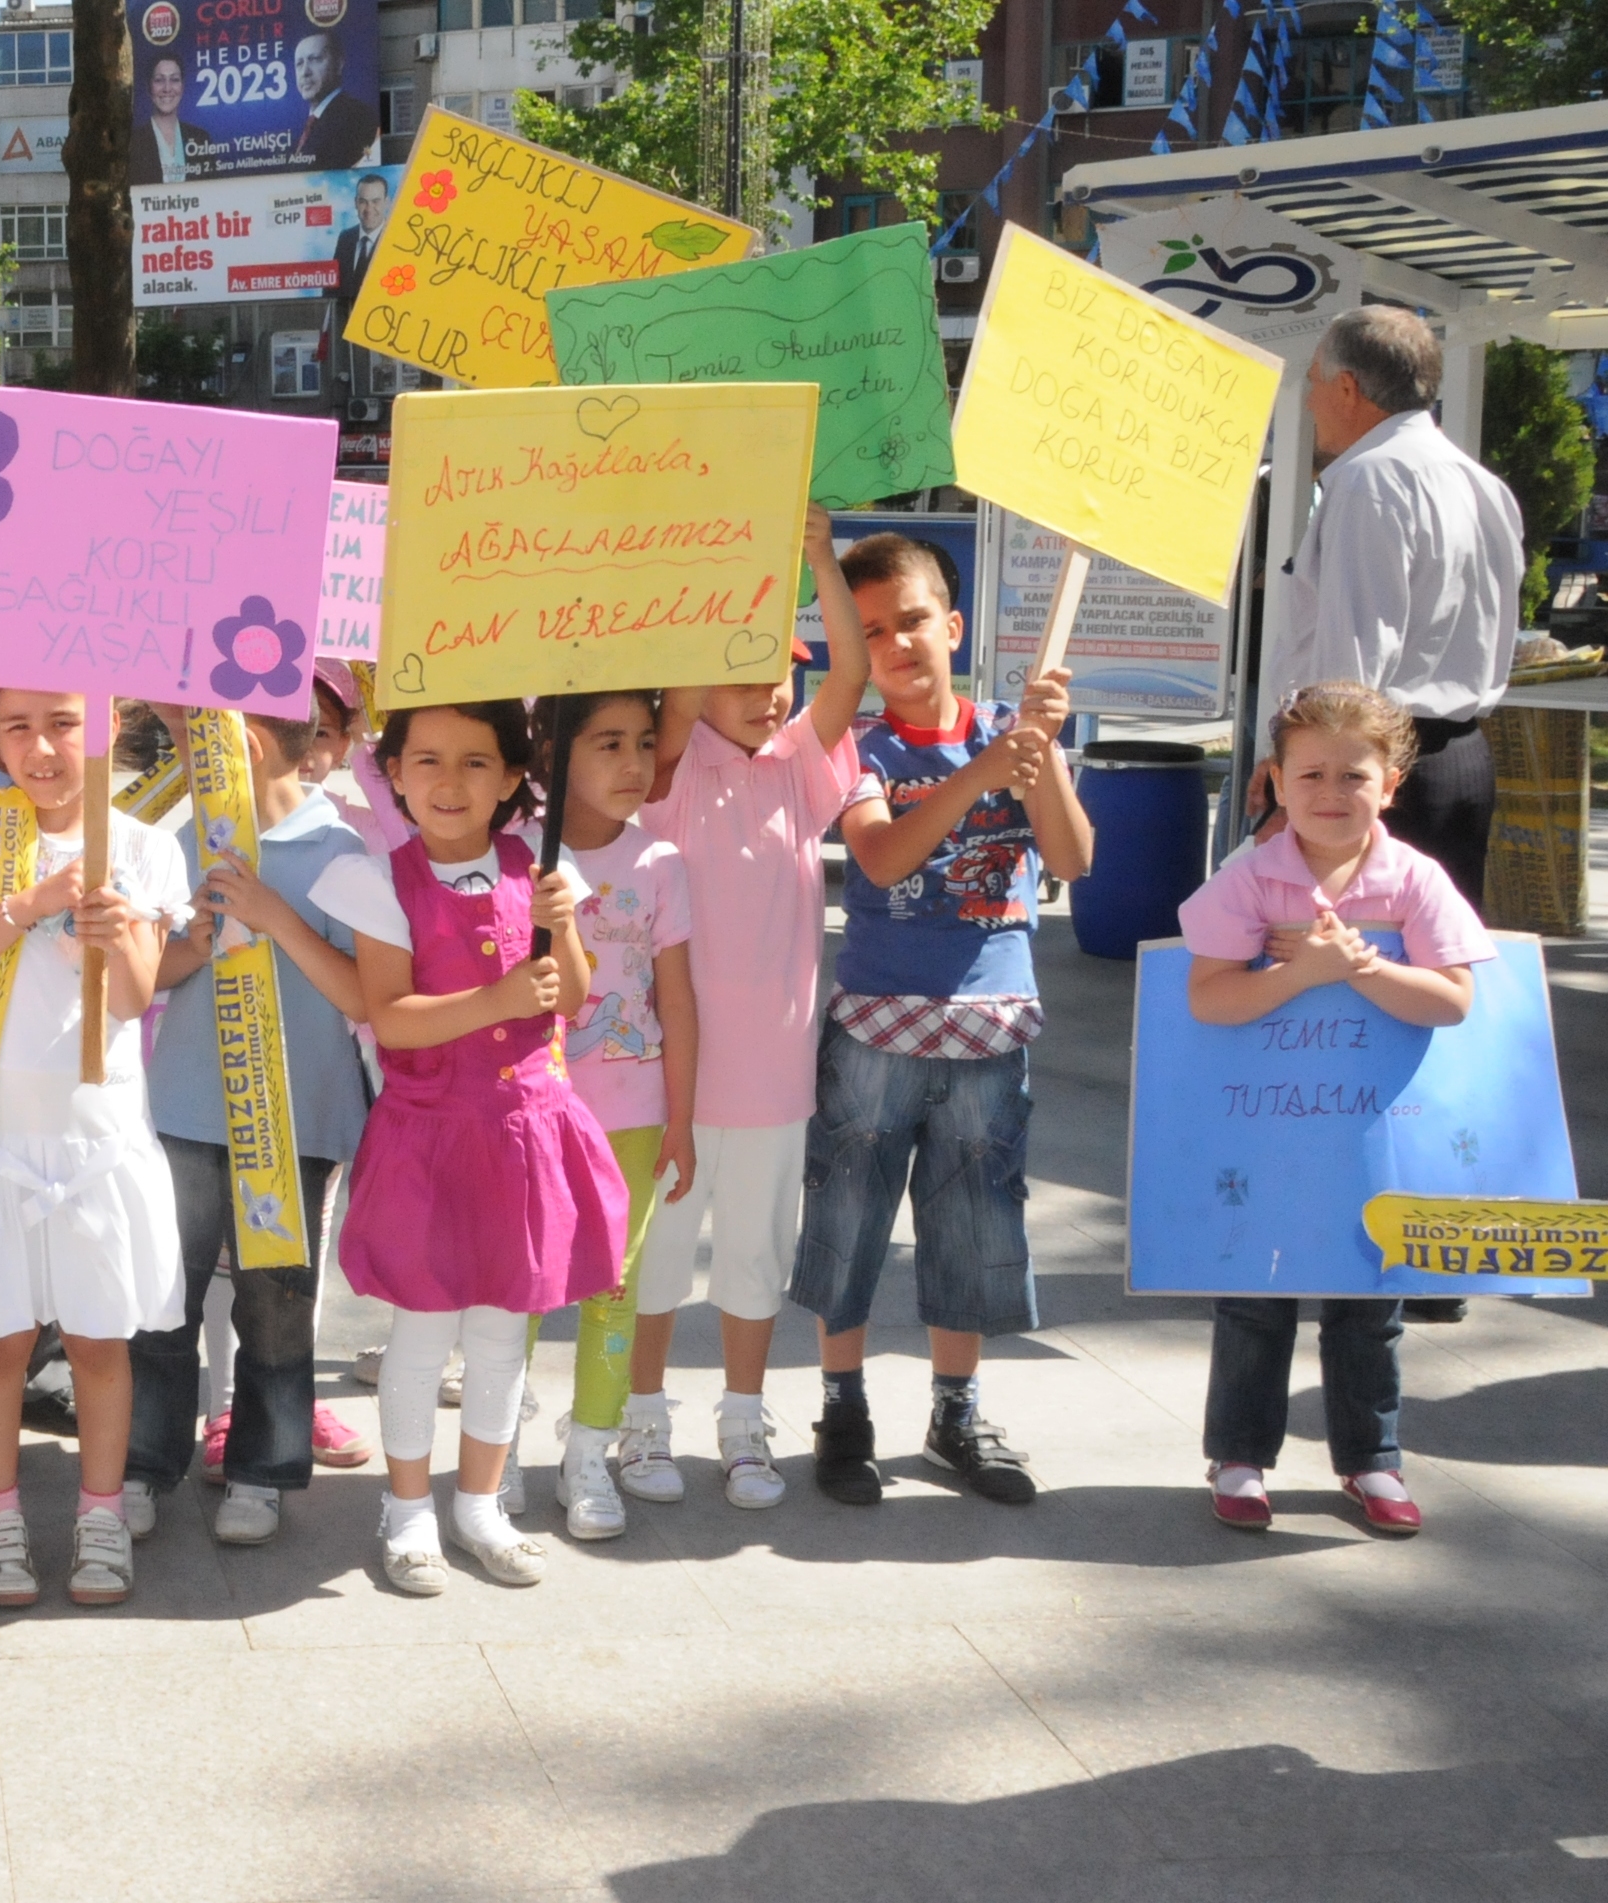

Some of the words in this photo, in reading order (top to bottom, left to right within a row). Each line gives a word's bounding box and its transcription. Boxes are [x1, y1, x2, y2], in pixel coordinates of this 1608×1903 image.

[197, 22, 284, 46] HAZIR
[196, 41, 284, 67] HEDEF
[196, 61, 288, 107] 2023
[36, 136, 67, 148] ABA
[185, 138, 230, 157] Özlem
[234, 129, 292, 152] YEMİŞÇİ
[141, 196, 200, 213] Türkiye
[275, 212, 300, 225] CHP
[141, 215, 209, 243] rahat
[216, 211, 251, 238] bir
[518, 205, 664, 279] YAŞAM
[142, 245, 213, 273] nefes
[143, 278, 198, 295] alacak.
[231, 279, 248, 291] Av.
[251, 276, 281, 290] EMRE
[285, 270, 337, 288] KÖPRÜLÜ
[364, 305, 477, 382] OLUR.
[1044, 269, 1100, 322] BİZ
[1116, 306, 1242, 399] DOĞAYI
[1072, 332, 1254, 456] KORUDUKÇA
[1009, 355, 1105, 431] DOĞA
[1117, 409, 1150, 453] DA
[1170, 433, 1236, 489] BİZİ
[52, 426, 224, 480] DOĞAYI
[1033, 423, 1152, 500] KORUR
[145, 485, 296, 544] YEŞİLİ
[84, 535, 216, 585] KORU
[425, 609, 518, 656] CAN
[538, 574, 779, 642] VERELİM!
[1082, 609, 1144, 622] YAPILACAK
[1148, 609, 1192, 624] ÇEKİLİŞ
[1197, 610, 1215, 624] İLE
[1086, 622, 1127, 636] HEDİYE
[215, 975, 259, 1172] HAZERFAN
